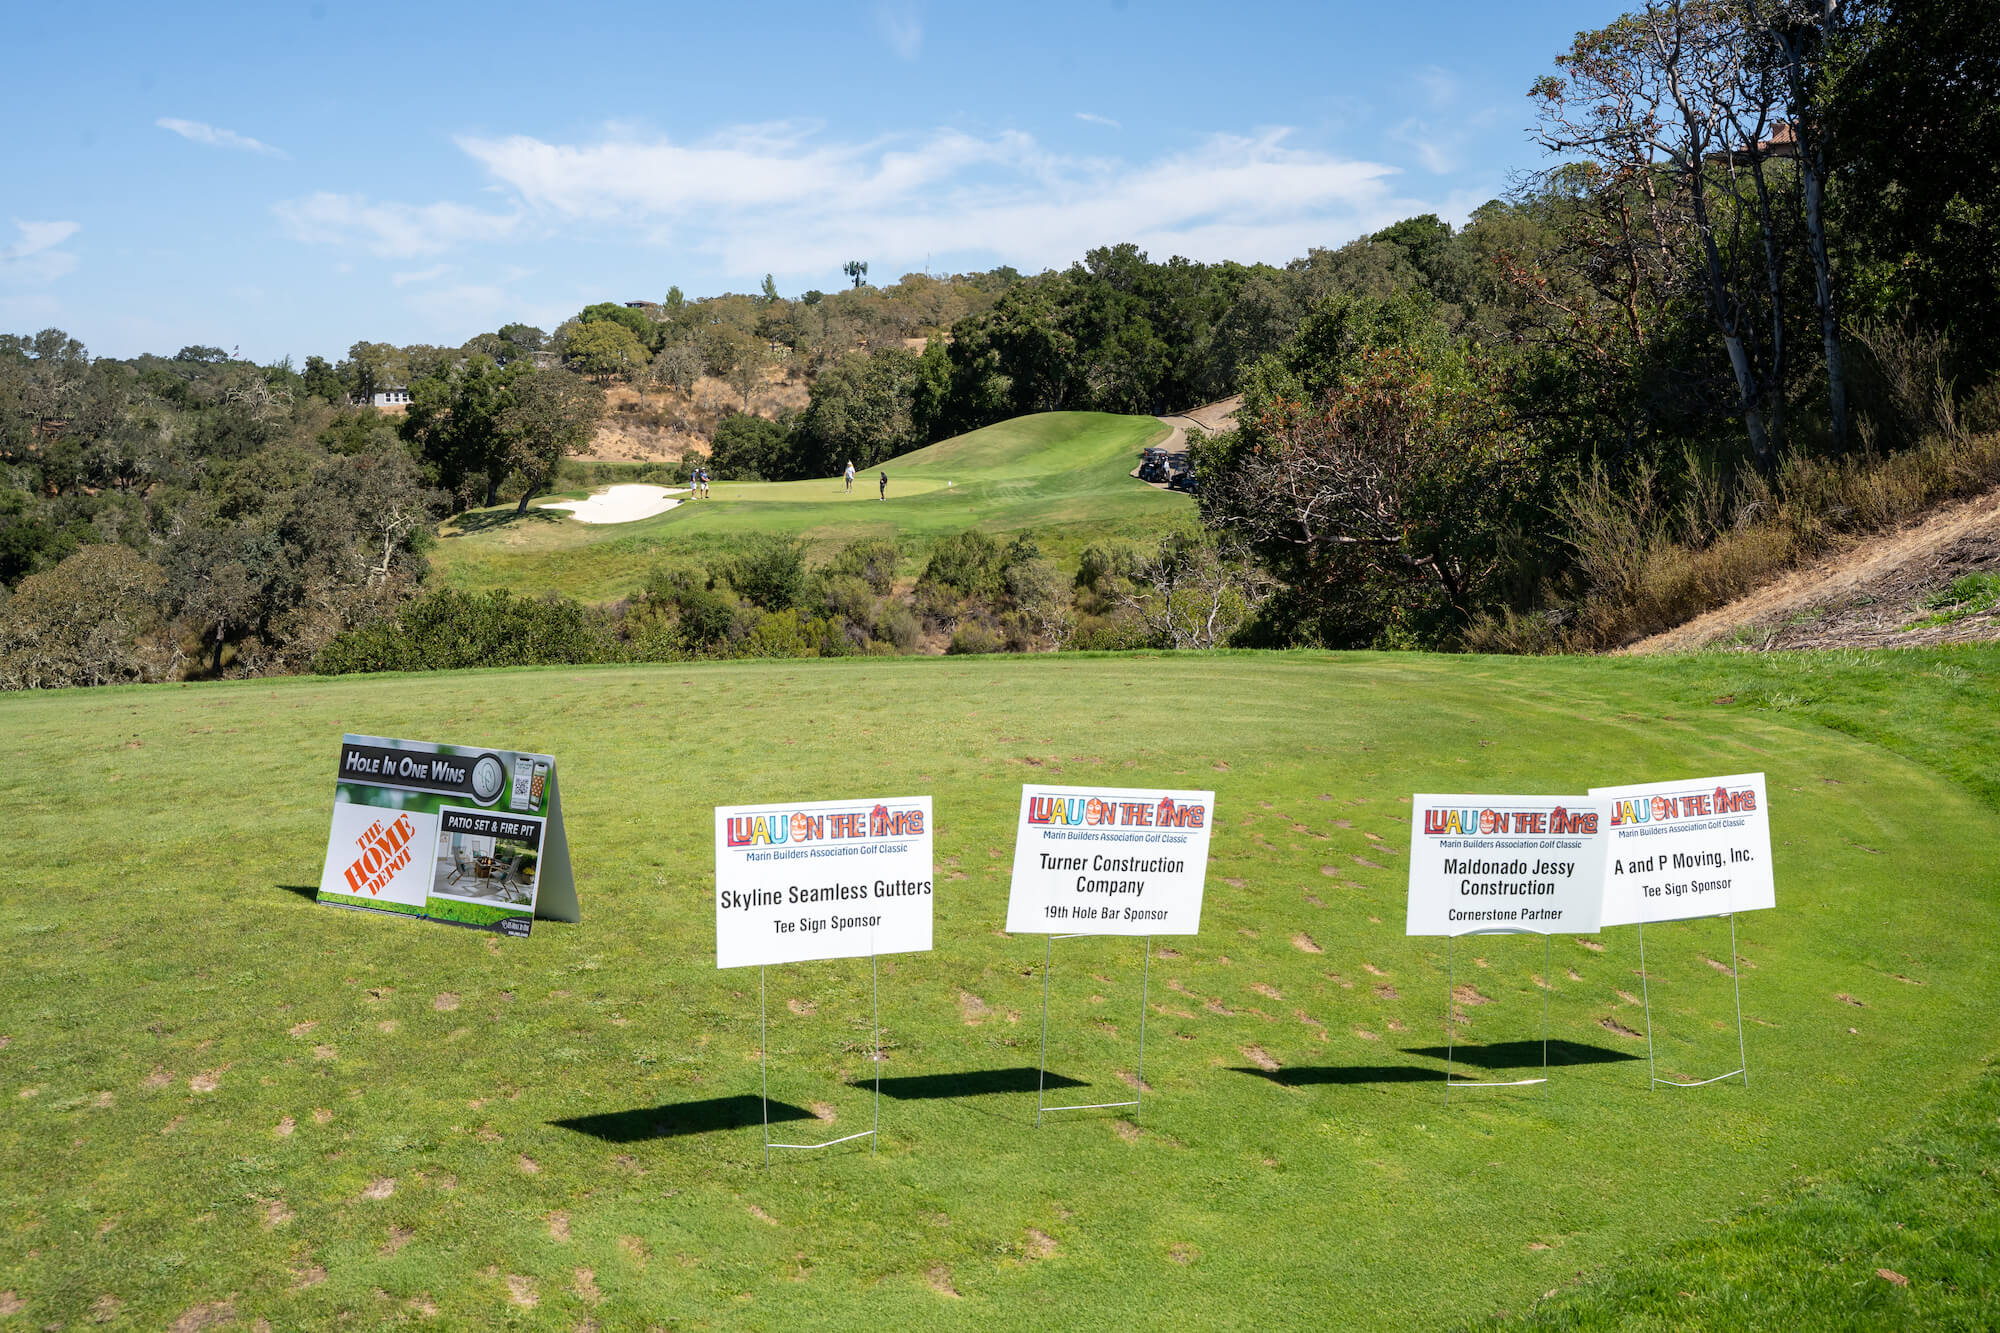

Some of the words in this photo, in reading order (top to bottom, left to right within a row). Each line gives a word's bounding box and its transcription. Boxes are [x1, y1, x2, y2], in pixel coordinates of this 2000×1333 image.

[1679, 795, 1712, 817] THE
[1713, 786, 1757, 814] LINKS
[1028, 797, 1085, 826] LUAU
[1119, 803, 1153, 826] THE
[1155, 797, 1205, 828] LINKS
[1424, 809, 1478, 835] LUAU
[1512, 812, 1547, 834] THE
[1550, 806, 1599, 835] LINKS
[355, 819, 384, 851] THE
[448, 815, 472, 829] PATIO
[474, 819, 490, 831] SET
[491, 821, 497, 832] &
[500, 822, 519, 835] FIRE
[520, 825, 535, 836] PIT
[727, 815, 788, 847] LUAU
[826, 813, 866, 839] THE
[870, 804, 924, 838] LINKS
[1618, 830, 1639, 838] Marin
[1640, 827, 1668, 836] Builders
[1669, 823, 1707, 833] Association
[1708, 821, 1721, 829] Golf
[1722, 818, 1745, 828] Classic
[1043, 830, 1066, 840] Marin
[1067, 831, 1099, 841] Builders
[1100, 832, 1144, 842] Association
[1145, 833, 1161, 843] Golf
[1162, 834, 1188, 844] Classic
[1440, 839, 1462, 848] Marin
[1463, 839, 1494, 848] Builders
[1495, 840, 1538, 849] Association
[1540, 840, 1555, 849] Golf
[1556, 840, 1582, 849] Classic
[344, 813, 416, 893] HOME
[746, 852, 772, 861] Marin
[773, 849, 809, 860] Builders
[810, 846, 858, 857] Association
[860, 845, 877, 855] Golf
[879, 843, 908, 853] Classic
[1614, 860, 1624, 875] A
[1629, 856, 1654, 874] and
[1659, 855, 1668, 871] P
[1673, 851, 1726, 869] Moving,
[1730, 848, 1754, 863] Inc.
[368, 846, 411, 896] DEPOT
[1040, 853, 1088, 871] Turner
[1093, 855, 1184, 873] Construction
[1444, 858, 1527, 875] Maldonado
[1532, 858, 1575, 878] Jessy
[721, 889, 782, 911] Skyline
[789, 883, 868, 904] Seamless
[874, 880, 931, 898] Gutters
[1076, 876, 1145, 896] Company
[1461, 879, 1555, 895] Construction
[1642, 885, 1661, 897] Tee
[1665, 882, 1688, 897] Sign
[1691, 879, 1732, 894] Sponsor
[774, 920, 795, 933] Tee
[800, 918, 826, 933] Sign
[831, 915, 881, 931] Sponsor
[1044, 906, 1068, 919] 19th
[1072, 906, 1097, 919] Hole
[1101, 907, 1120, 920] Bar
[1124, 907, 1168, 922] Sponsor
[1449, 909, 1517, 921] Cornerstone
[1521, 908, 1563, 920] Partner
